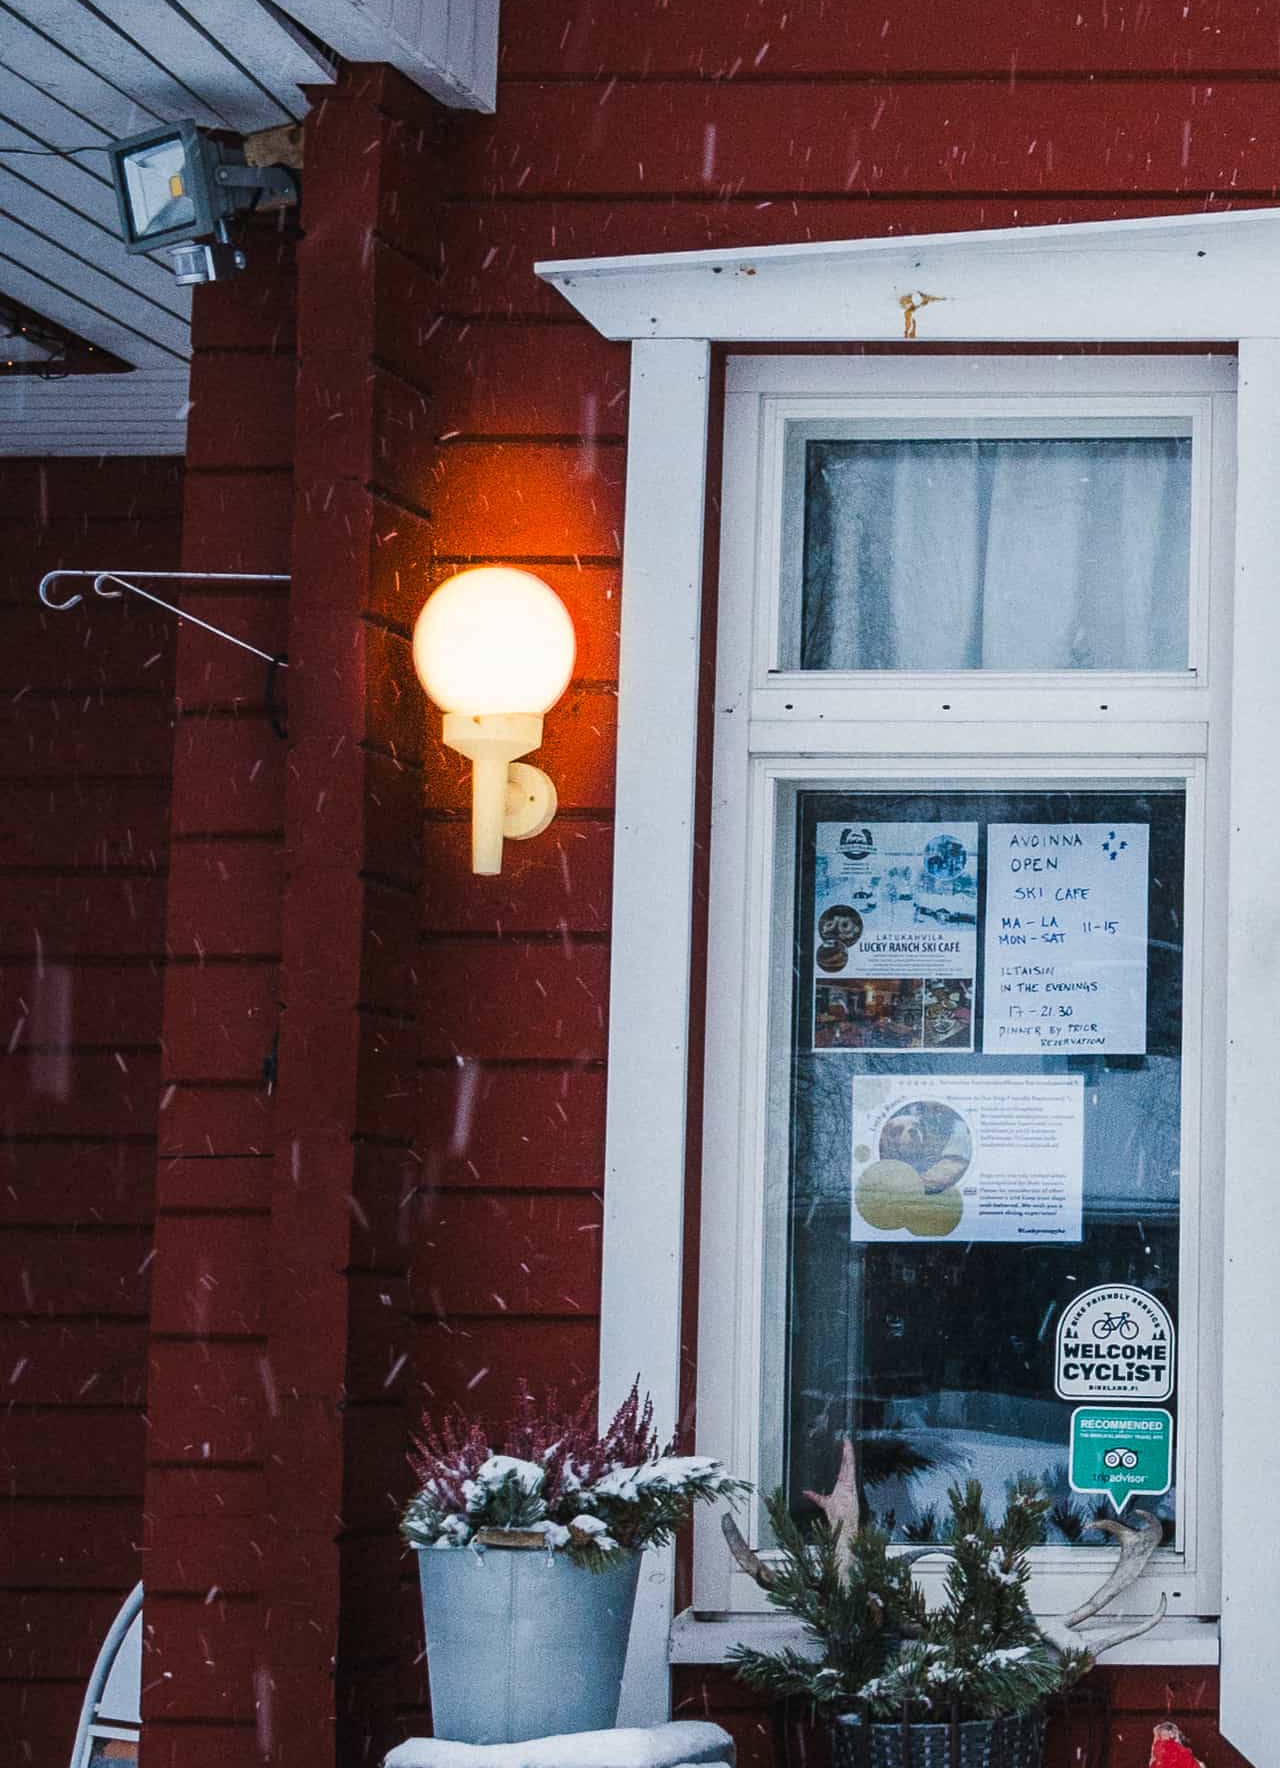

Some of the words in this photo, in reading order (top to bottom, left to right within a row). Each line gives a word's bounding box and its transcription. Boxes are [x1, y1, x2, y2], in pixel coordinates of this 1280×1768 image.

[1009, 833, 1083, 848] AVOINNA
[1010, 857, 1058, 872] OPEN
[1014, 887, 1043, 900] SKI
[1055, 888, 1090, 901] CAFE
[1001, 917, 1021, 929] MA
[1042, 916, 1059, 928] LA
[998, 934, 1026, 945] MON
[1041, 933, 1066, 944] SAT
[860, 942, 887, 952] LUCKY
[889, 942, 920, 952] RANCH
[921, 942, 937, 952] SKI
[1000, 983, 1011, 992] IN
[1016, 983, 1039, 992] THE
[1045, 981, 1098, 993] EVENINGS
[1063, 1343, 1167, 1361] WELCOME
[1080, 1419, 1163, 1431] RECOMMENDED
[1093, 1473, 1145, 1484] tripadvisor
